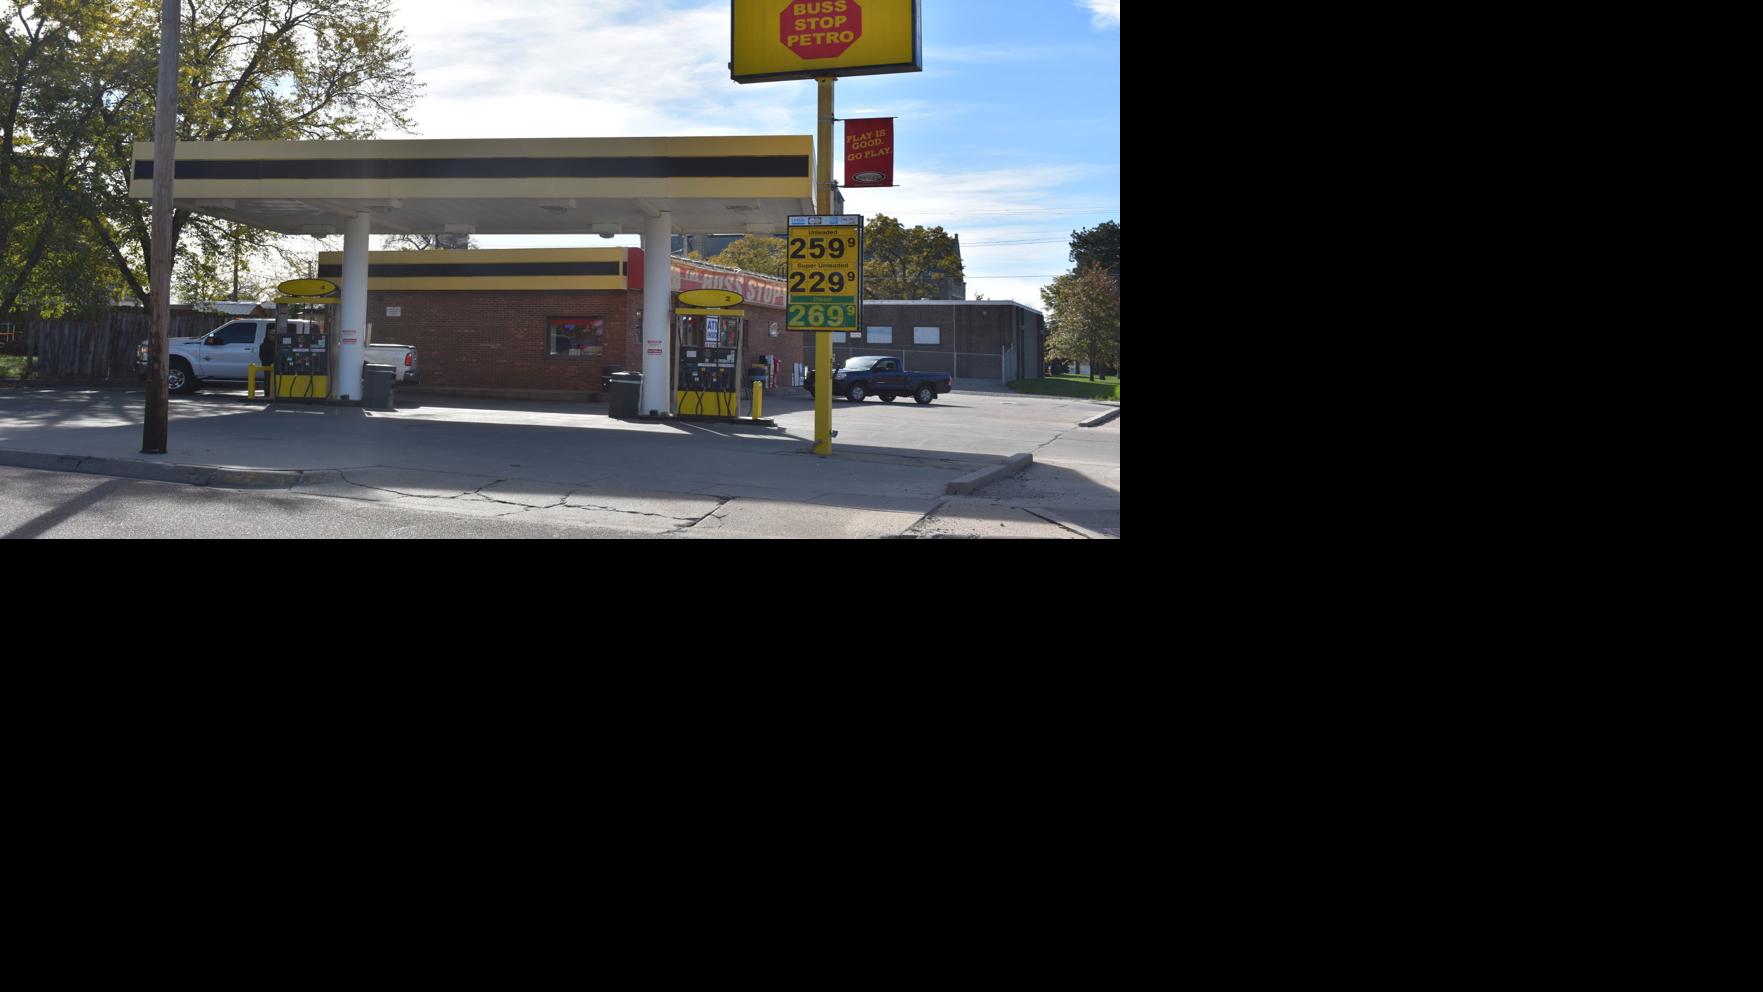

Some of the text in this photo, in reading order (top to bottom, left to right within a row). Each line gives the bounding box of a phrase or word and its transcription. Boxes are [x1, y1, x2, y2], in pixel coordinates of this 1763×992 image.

[793, 0, 847, 15] BUSS
[794, 15, 847, 31] STOP
[787, 31, 854, 47] PETRO
[847, 129, 886, 143] PLAY IS
[848, 152, 863, 161] GO
[790, 236, 856, 259] 259 9
[790, 271, 856, 293] 229 9
[747, 280, 782, 304] STOP
[788, 304, 855, 327] 269 9
